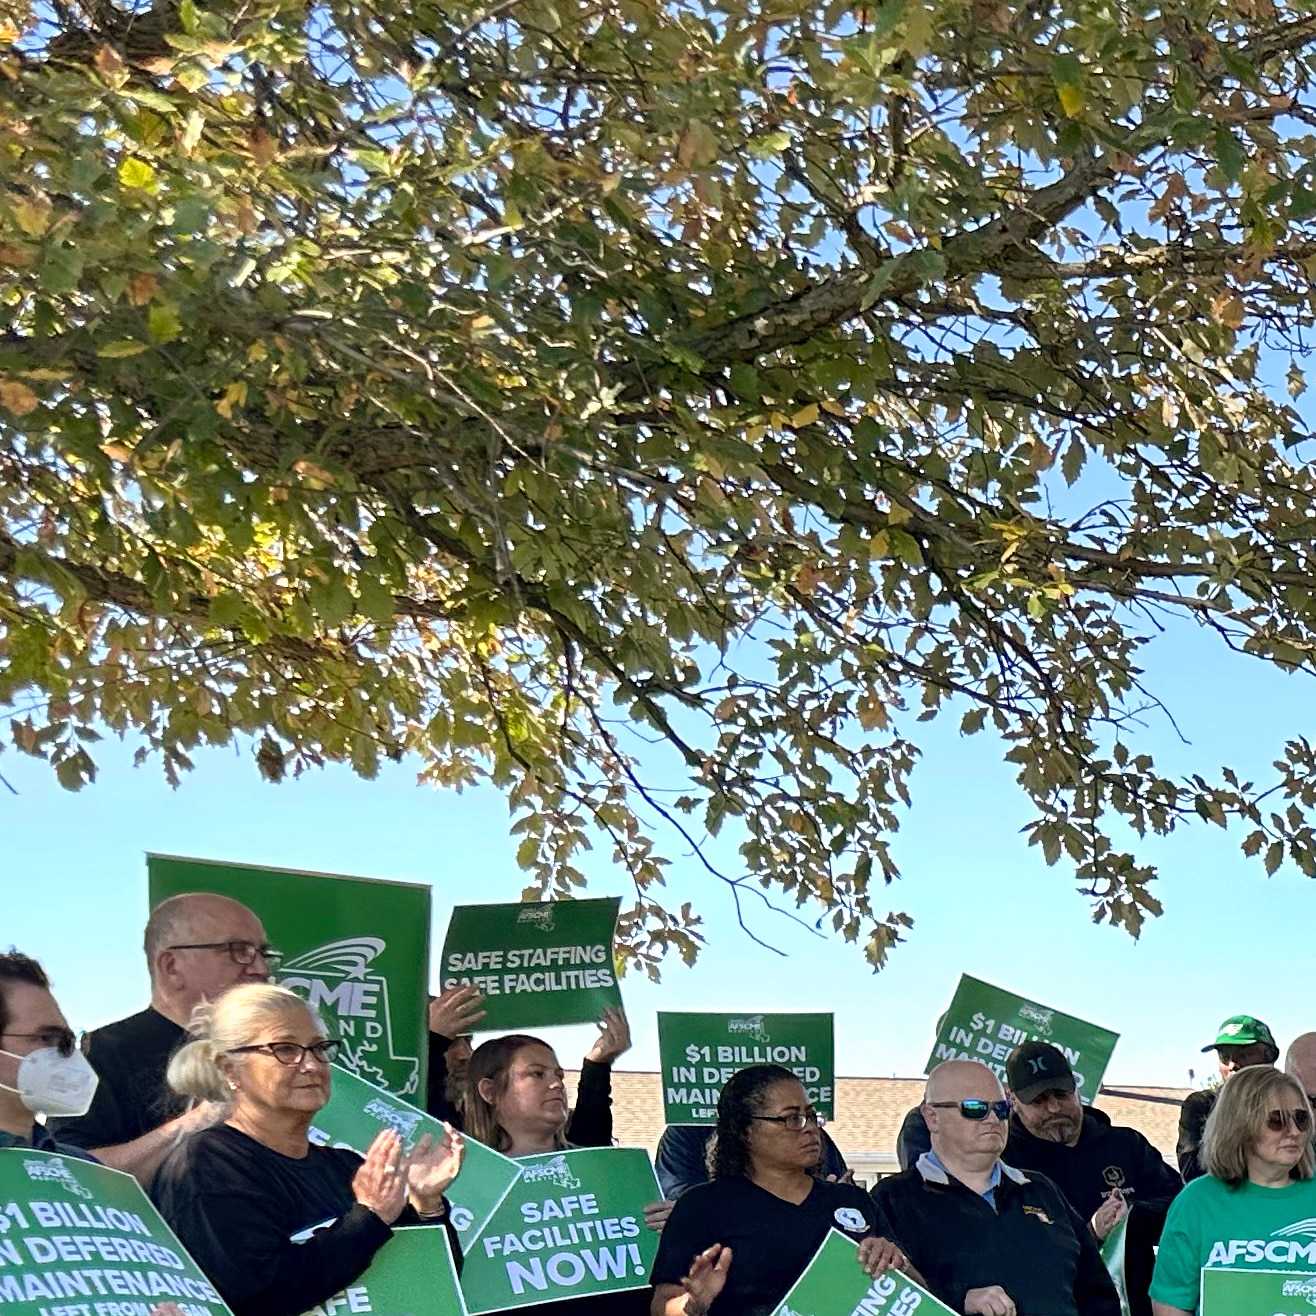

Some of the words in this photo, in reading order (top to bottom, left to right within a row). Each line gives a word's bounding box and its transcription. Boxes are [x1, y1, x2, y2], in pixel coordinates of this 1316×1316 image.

[448, 951, 503, 971] SAFE
[506, 945, 606, 968] STAFFING
[504, 969, 614, 993] FACILITIES
[970, 1012, 995, 1034] $1
[949, 1026, 974, 1047] IN
[686, 1044, 710, 1064] $1
[718, 1046, 806, 1062] BILLION
[672, 1067, 696, 1083] IN
[29, 1201, 152, 1237] BILLION
[521, 1194, 599, 1223] SAFE
[483, 1217, 640, 1258] FACILITIES
[23, 1236, 184, 1270] DEFERRED
[506, 1243, 645, 1295] NOW!
